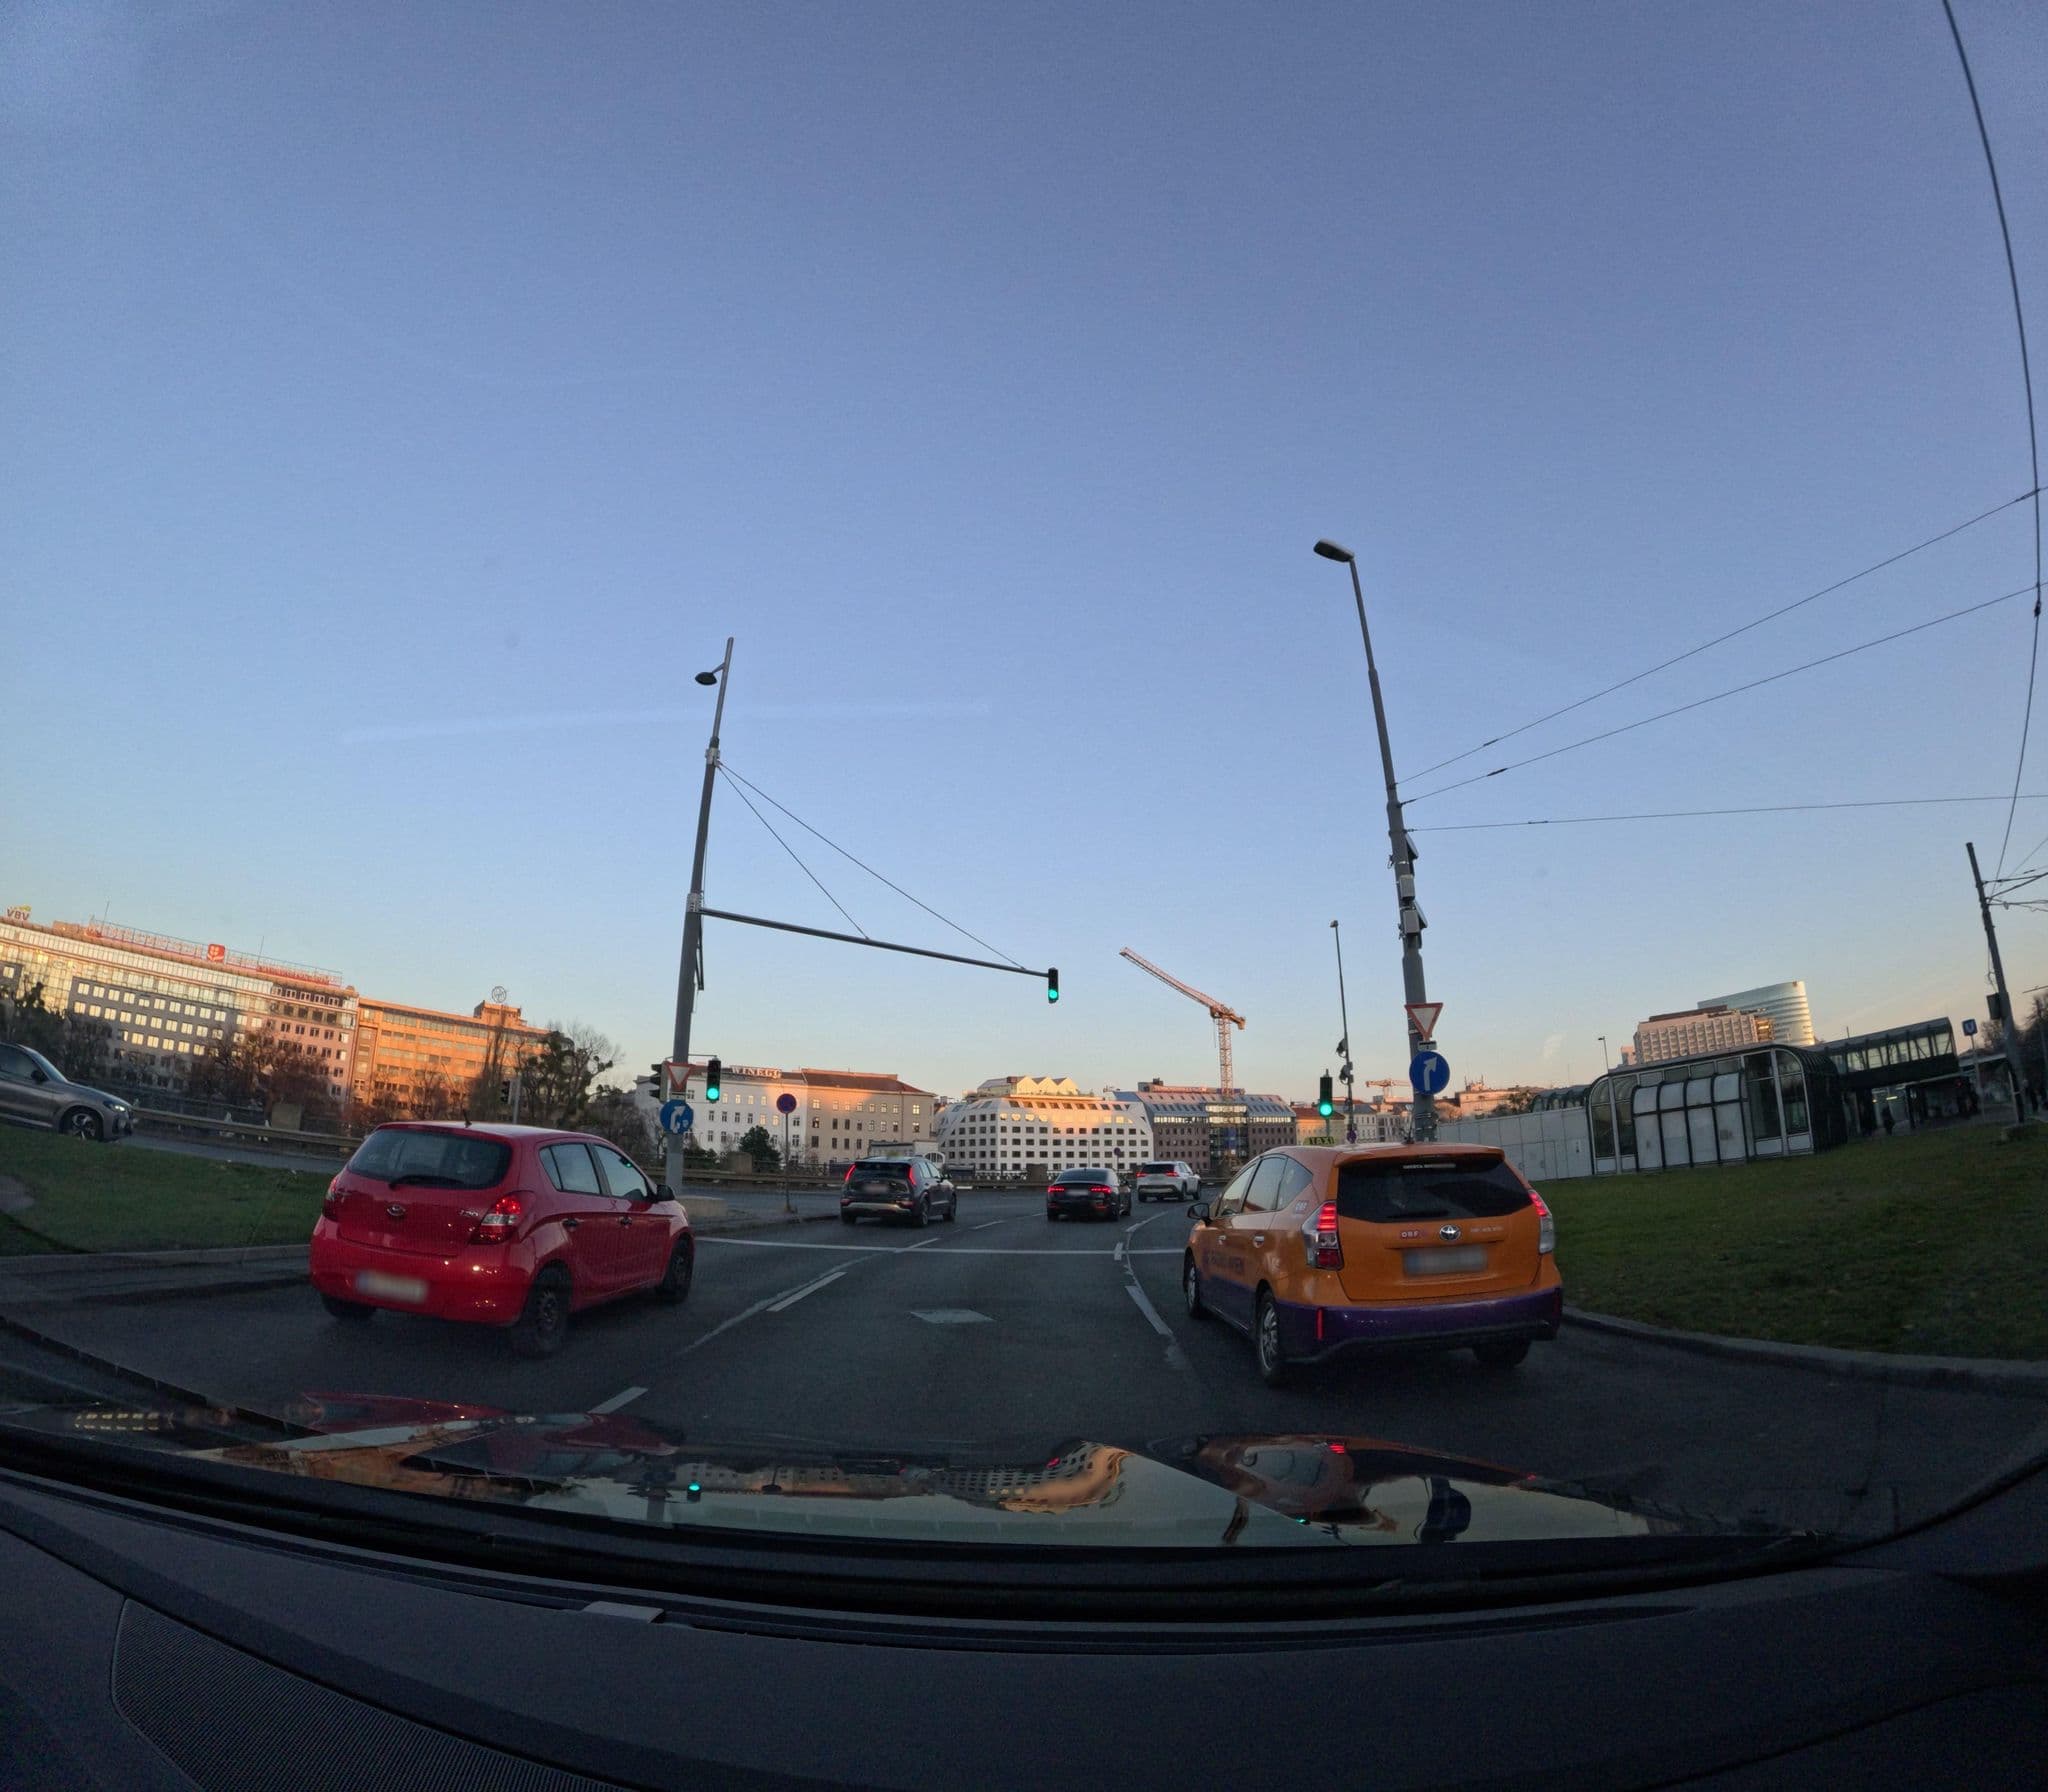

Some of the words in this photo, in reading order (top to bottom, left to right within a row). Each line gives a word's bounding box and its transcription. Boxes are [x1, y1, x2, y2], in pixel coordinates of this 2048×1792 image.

[7, 908, 30, 921] VBV
[1965, 1021, 1975, 1033] U
[731, 1066, 782, 1079] WINEGG
[1309, 1136, 1335, 1145] TAXI
